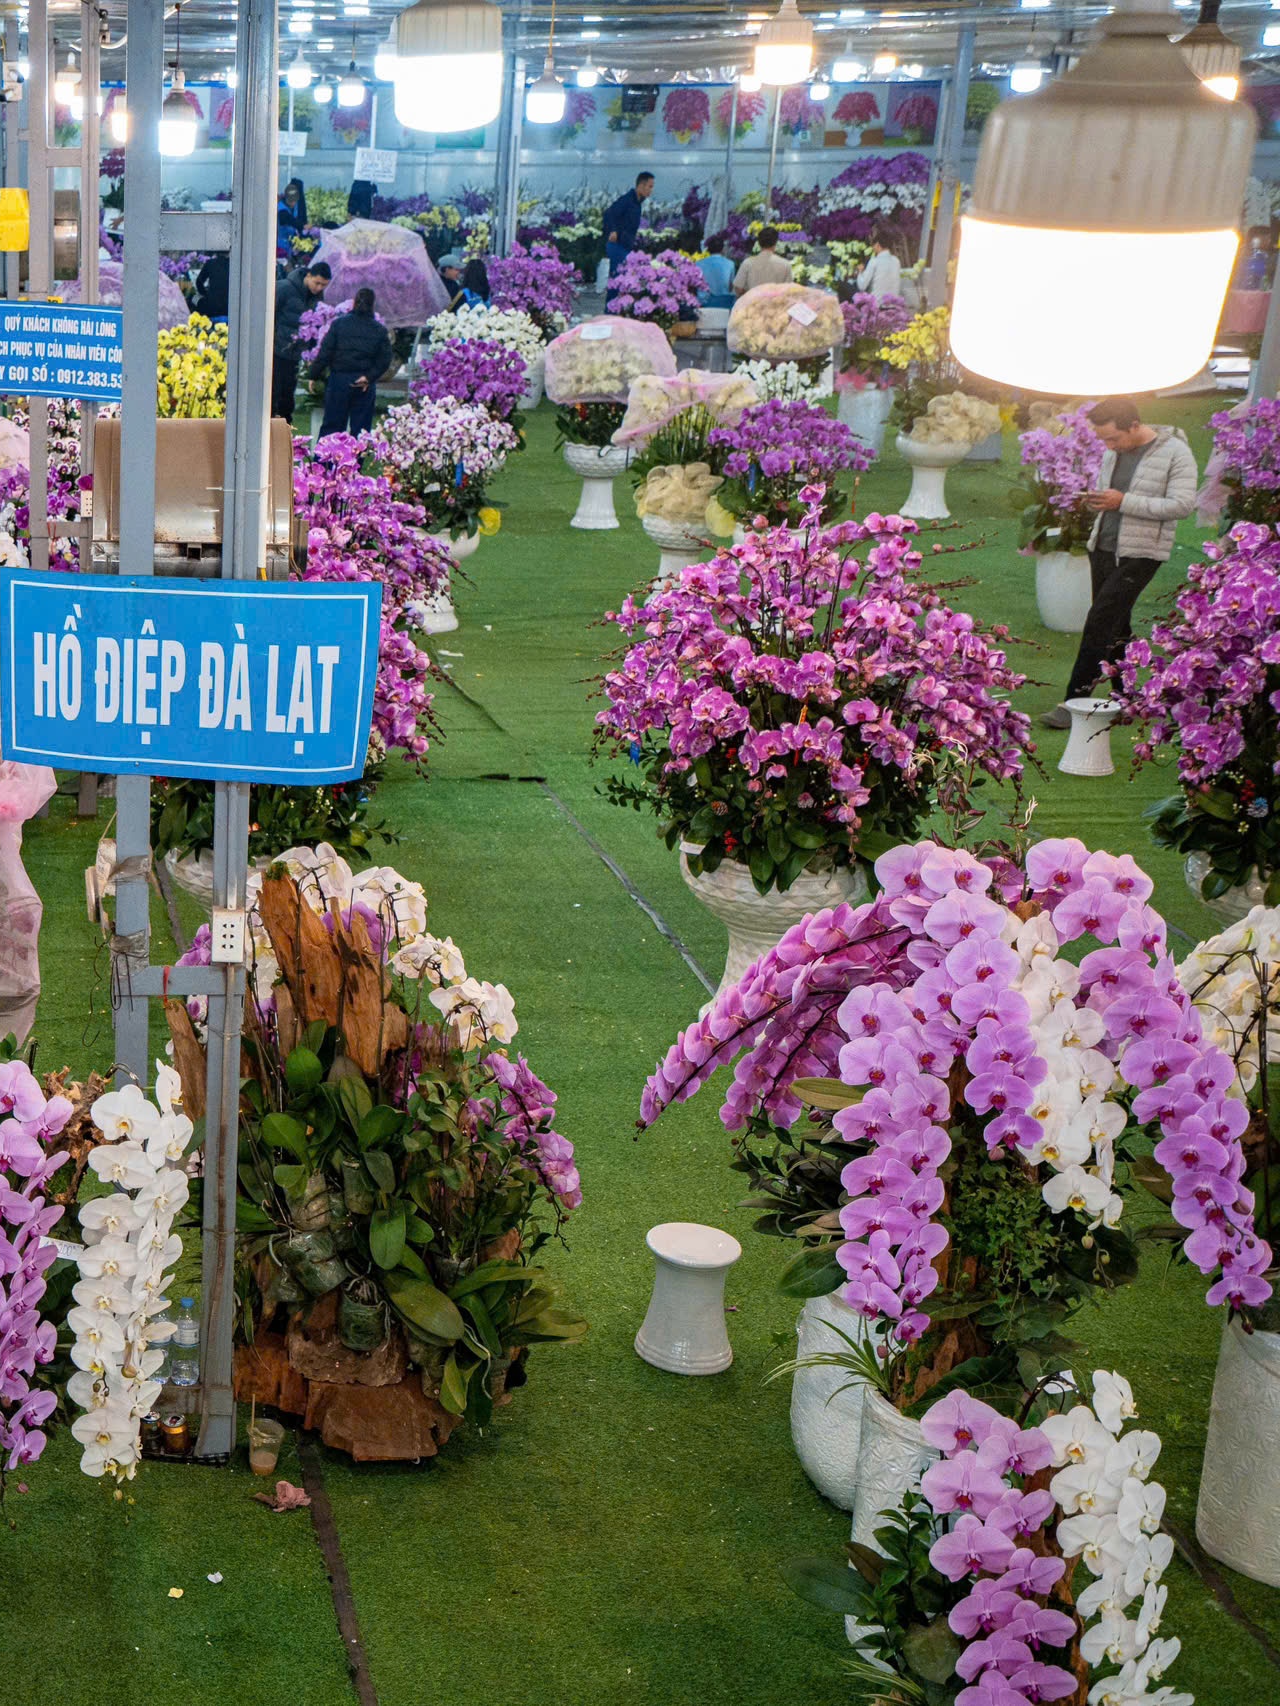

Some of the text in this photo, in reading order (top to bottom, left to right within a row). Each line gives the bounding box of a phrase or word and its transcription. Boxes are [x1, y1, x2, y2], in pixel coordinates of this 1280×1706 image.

[4, 313, 117, 338] QUÝ KHÁCH KHÔNG HÀI LÒNG
[10, 341, 33, 360] PHỤC
[35, 342, 46, 361] VỤ
[47, 339, 63, 358] CỦA
[65, 342, 87, 361] NHÂN
[88, 343, 107, 362] VIÊN
[108, 344, 123, 363] CÔN
[8, 365, 29, 384] GỌI
[32, 362, 49, 382] SỐ
[33, 603, 340, 755] HỒ ĐIỆP ĐÀ LẠT
